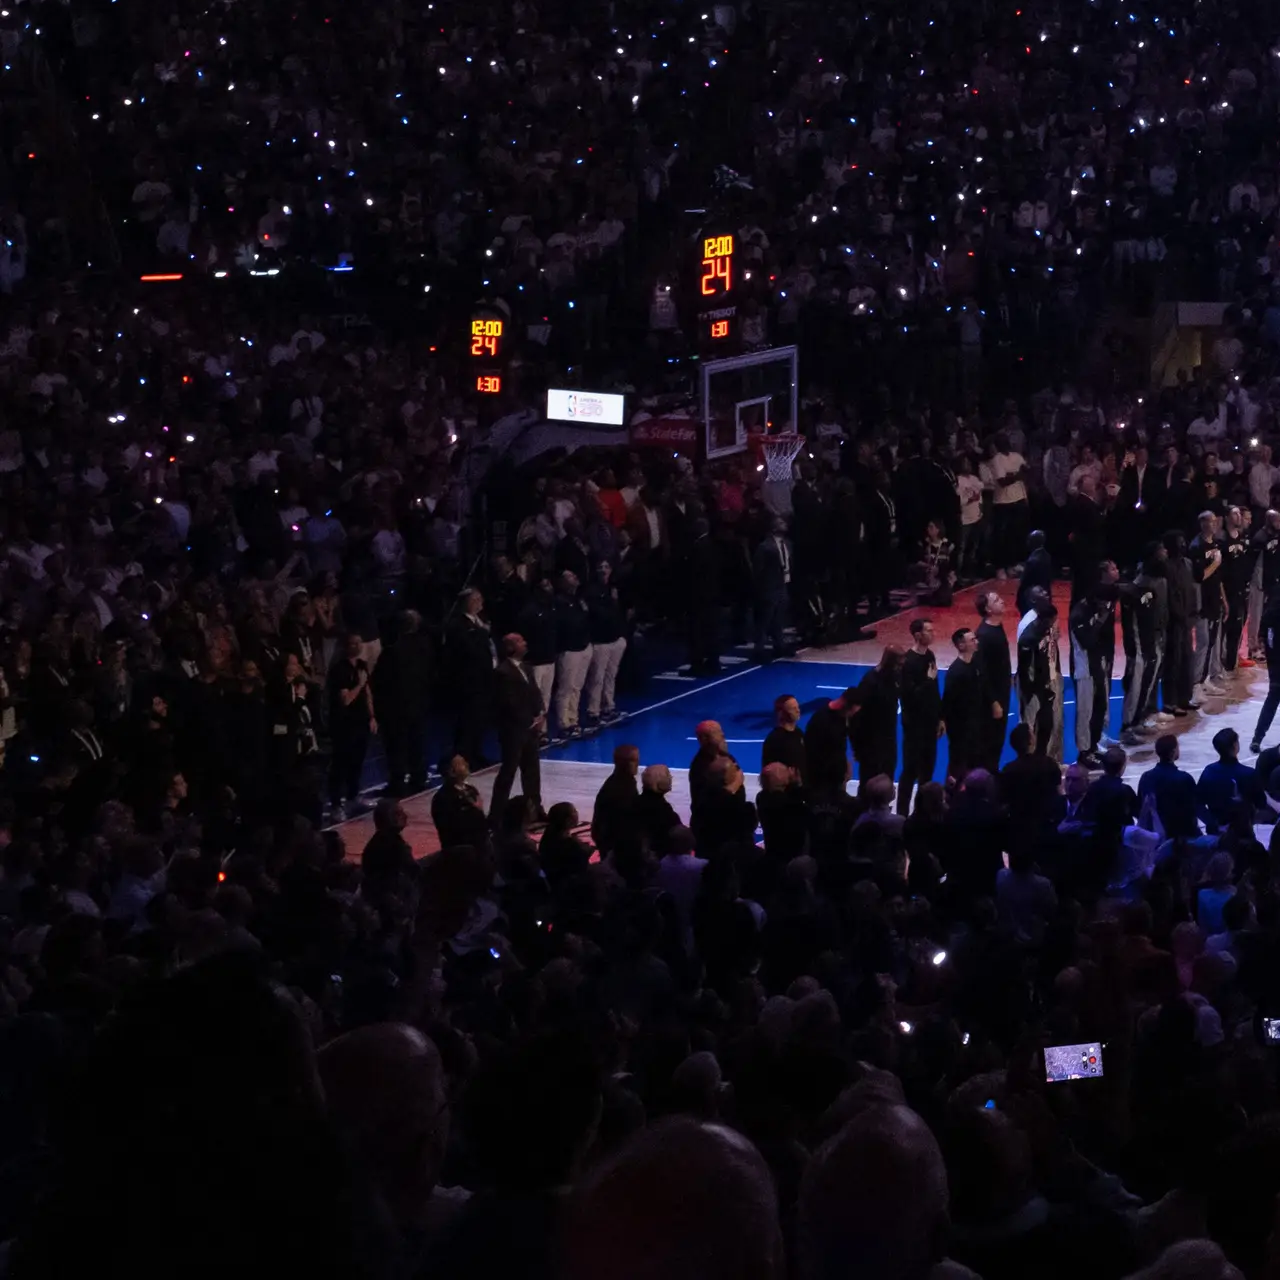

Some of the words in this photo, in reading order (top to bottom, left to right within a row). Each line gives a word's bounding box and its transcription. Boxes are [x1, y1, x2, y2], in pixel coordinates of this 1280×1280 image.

[704, 236, 733, 258] 12:00
[701, 257, 731, 295] 24
[471, 320, 503, 337] 12:00
[471, 336, 497, 356] 24
[476, 376, 500, 392] 1:30
[648, 426, 697, 441] StateFar
